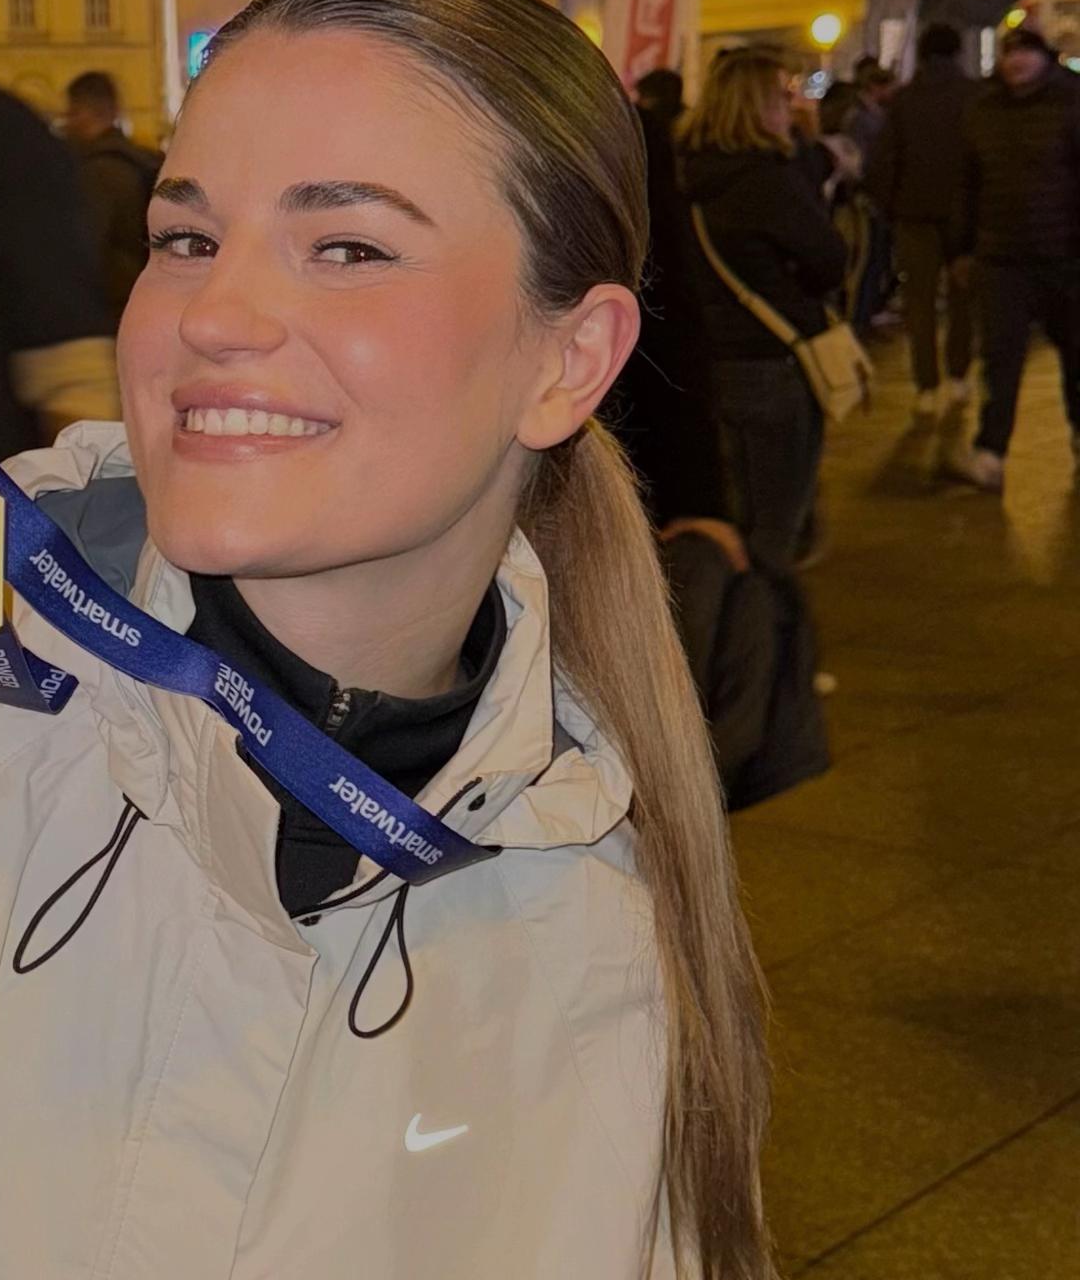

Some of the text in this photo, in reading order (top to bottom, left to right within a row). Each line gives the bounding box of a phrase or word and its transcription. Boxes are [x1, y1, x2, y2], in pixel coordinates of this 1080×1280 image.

[28, 548, 143, 648] smartwater
[39, 668, 67, 705] POW
[213, 676, 273, 747] POWER
[218, 662, 255, 703] ADE
[327, 775, 444, 866] smartwater
